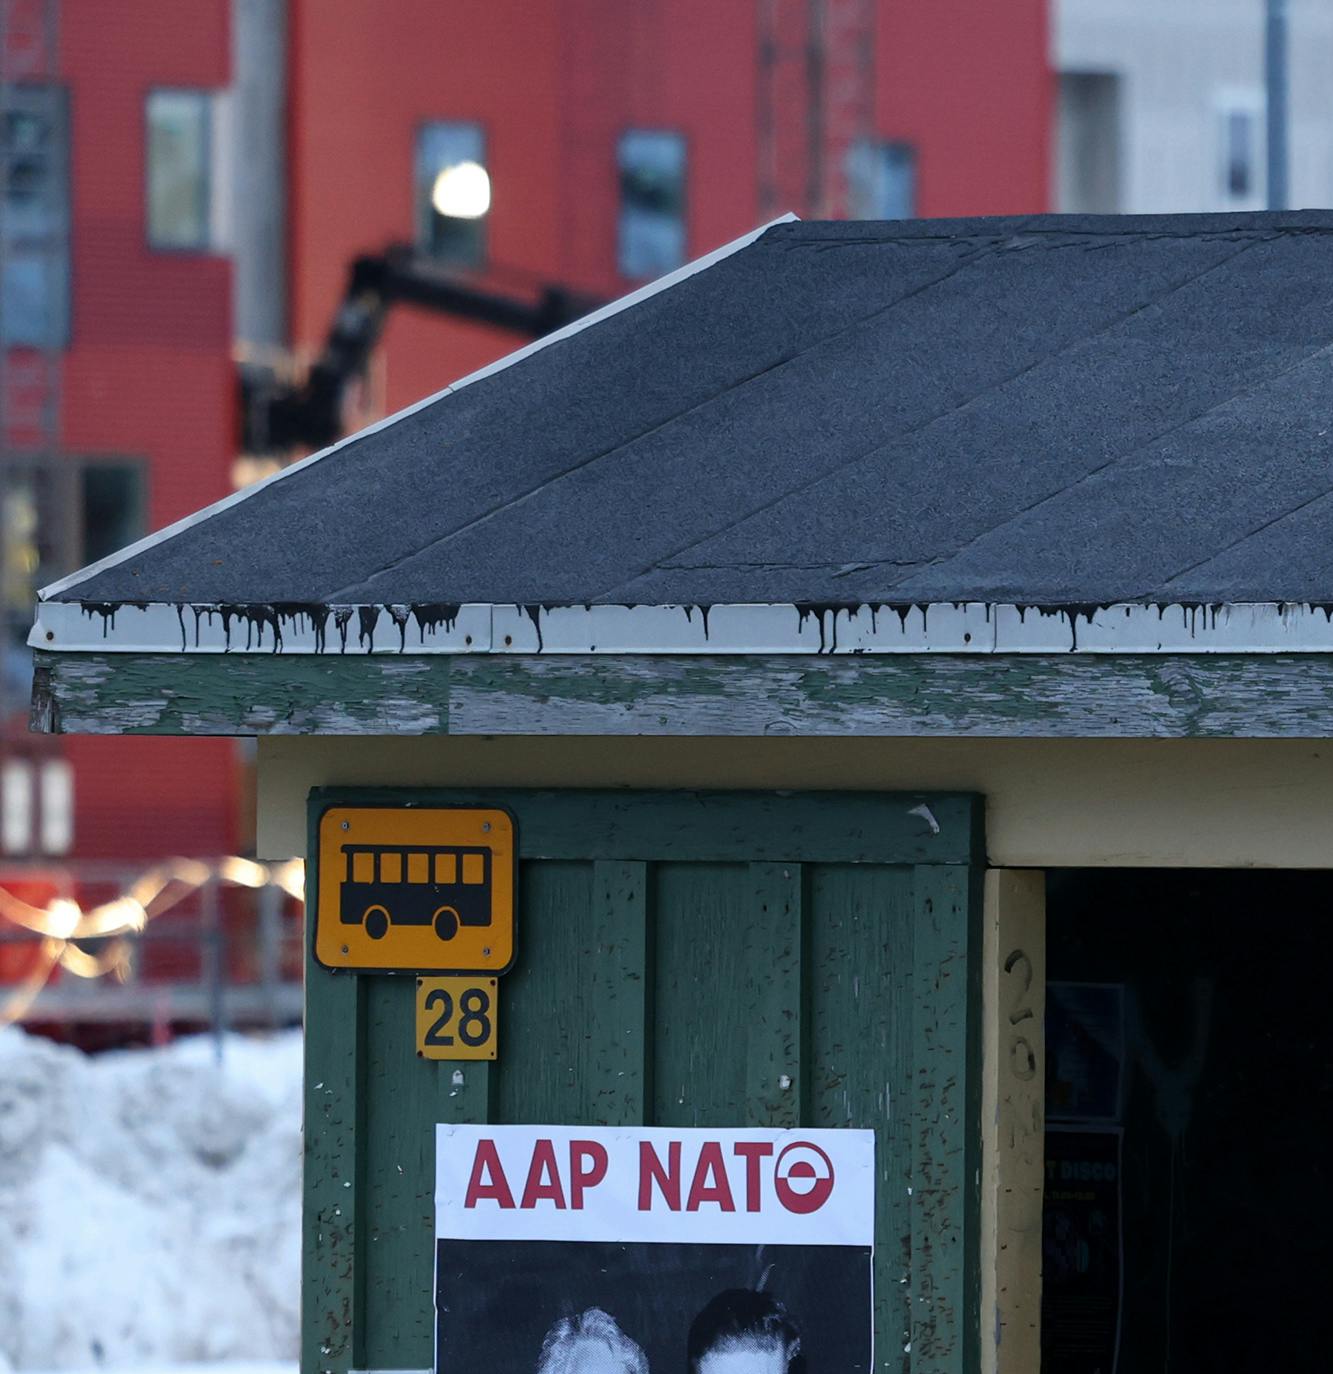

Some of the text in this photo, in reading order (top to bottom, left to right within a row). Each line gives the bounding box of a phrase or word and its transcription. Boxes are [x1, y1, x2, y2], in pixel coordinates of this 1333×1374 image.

[423, 988, 492, 1047] 28
[464, 1139, 835, 1214] AAP NATO
